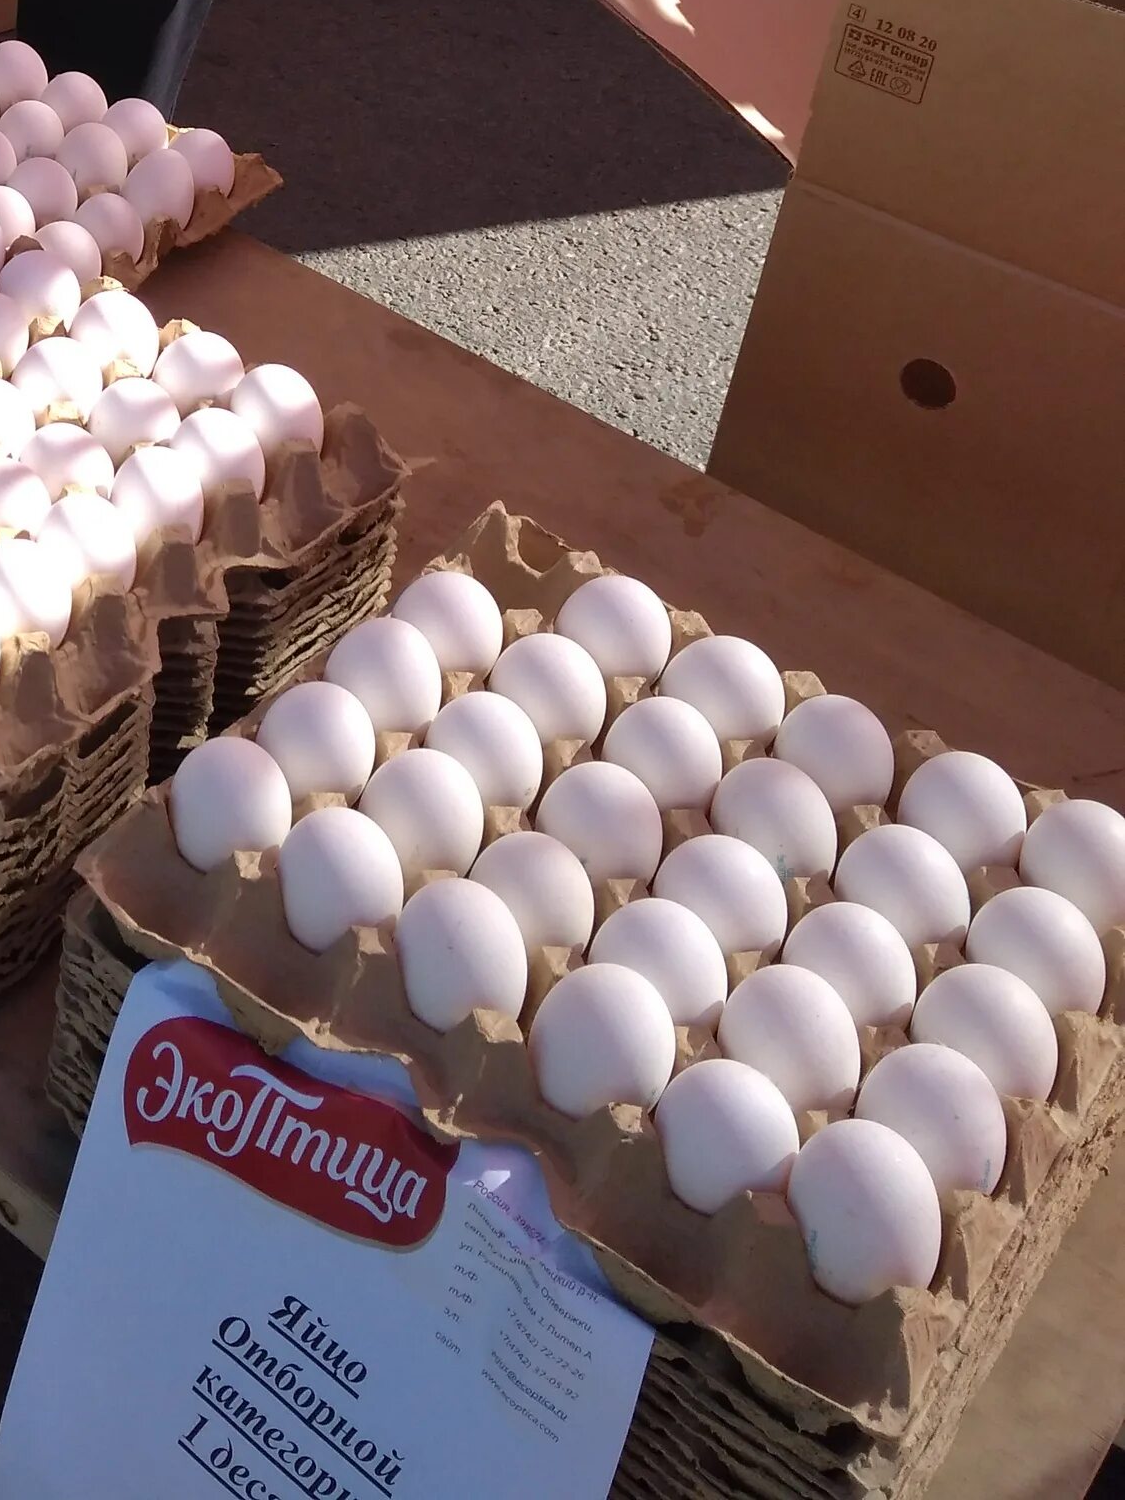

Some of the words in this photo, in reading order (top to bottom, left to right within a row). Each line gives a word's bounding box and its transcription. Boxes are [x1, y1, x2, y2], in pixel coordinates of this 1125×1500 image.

[862, 33, 890, 52] SFT
[890, 45, 929, 69] Group
[875, 18, 894, 35] 12
[898, 26, 916, 42] 08
[918, 35, 938, 52] 20
[135, 1041, 429, 1224] ЭкоПтица
[268, 1295, 368, 1384] Яйцо
[195, 1364, 360, 1500] категор
[218, 1316, 405, 1486] Отборной
[179, 1413, 209, 1447] 1
[209, 1437, 281, 1500] дес
